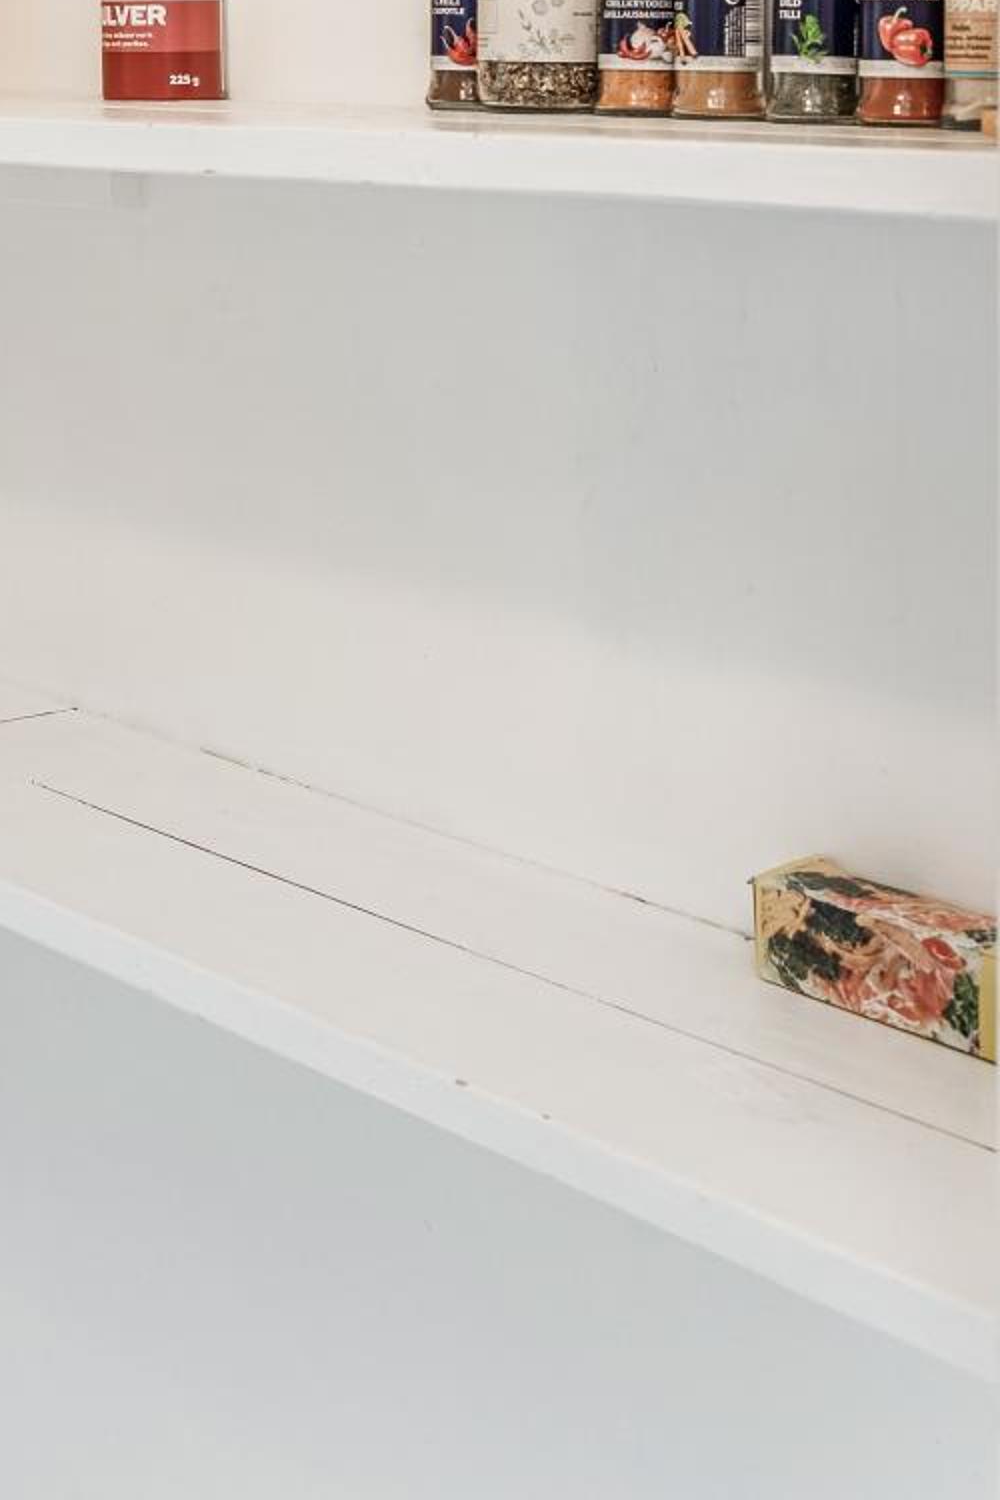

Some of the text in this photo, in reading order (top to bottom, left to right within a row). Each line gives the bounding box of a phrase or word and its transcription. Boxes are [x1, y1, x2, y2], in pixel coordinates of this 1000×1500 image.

[102, 3, 167, 26] LVER
[779, 9, 801, 19] TILLI
[169, 74, 191, 85] 225
